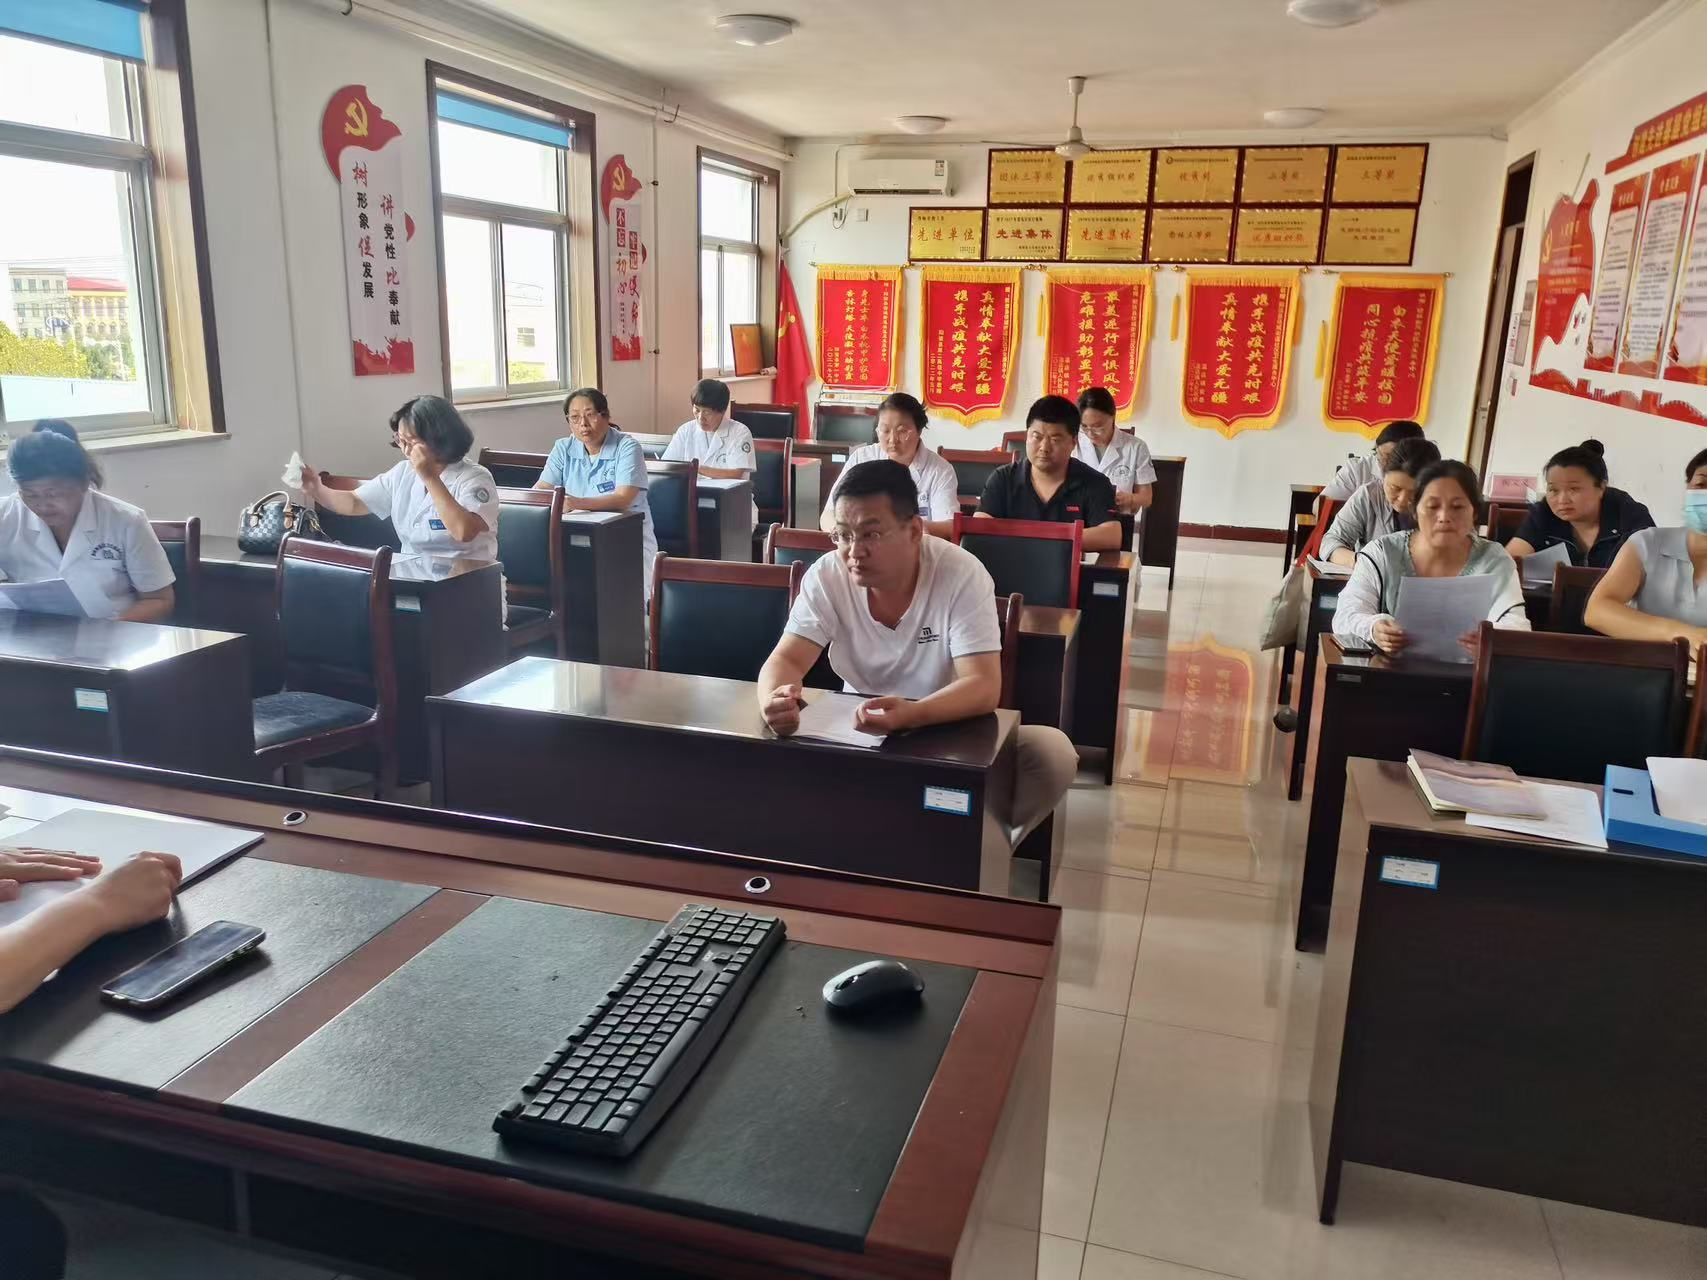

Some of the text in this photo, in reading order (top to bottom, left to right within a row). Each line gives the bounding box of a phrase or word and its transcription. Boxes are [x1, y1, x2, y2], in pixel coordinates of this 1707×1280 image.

[352, 162, 374, 299] 树形象促发展
[380, 194, 400, 325] 讲党性比奉献
[918, 227, 974, 241] 先进单位
[996, 228, 1053, 239] 先进集体
[1081, 228, 1132, 240] 先进集体
[949, 289, 969, 393] 携手战疫共克时艰
[975, 290, 996, 395] 真情奉献大爱无疆
[1102, 291, 1120, 397] 最美逆行无惧风险
[1211, 293, 1238, 404] 真情奉献大爱无疆
[1242, 293, 1269, 404] 携手战疫共克时艰
